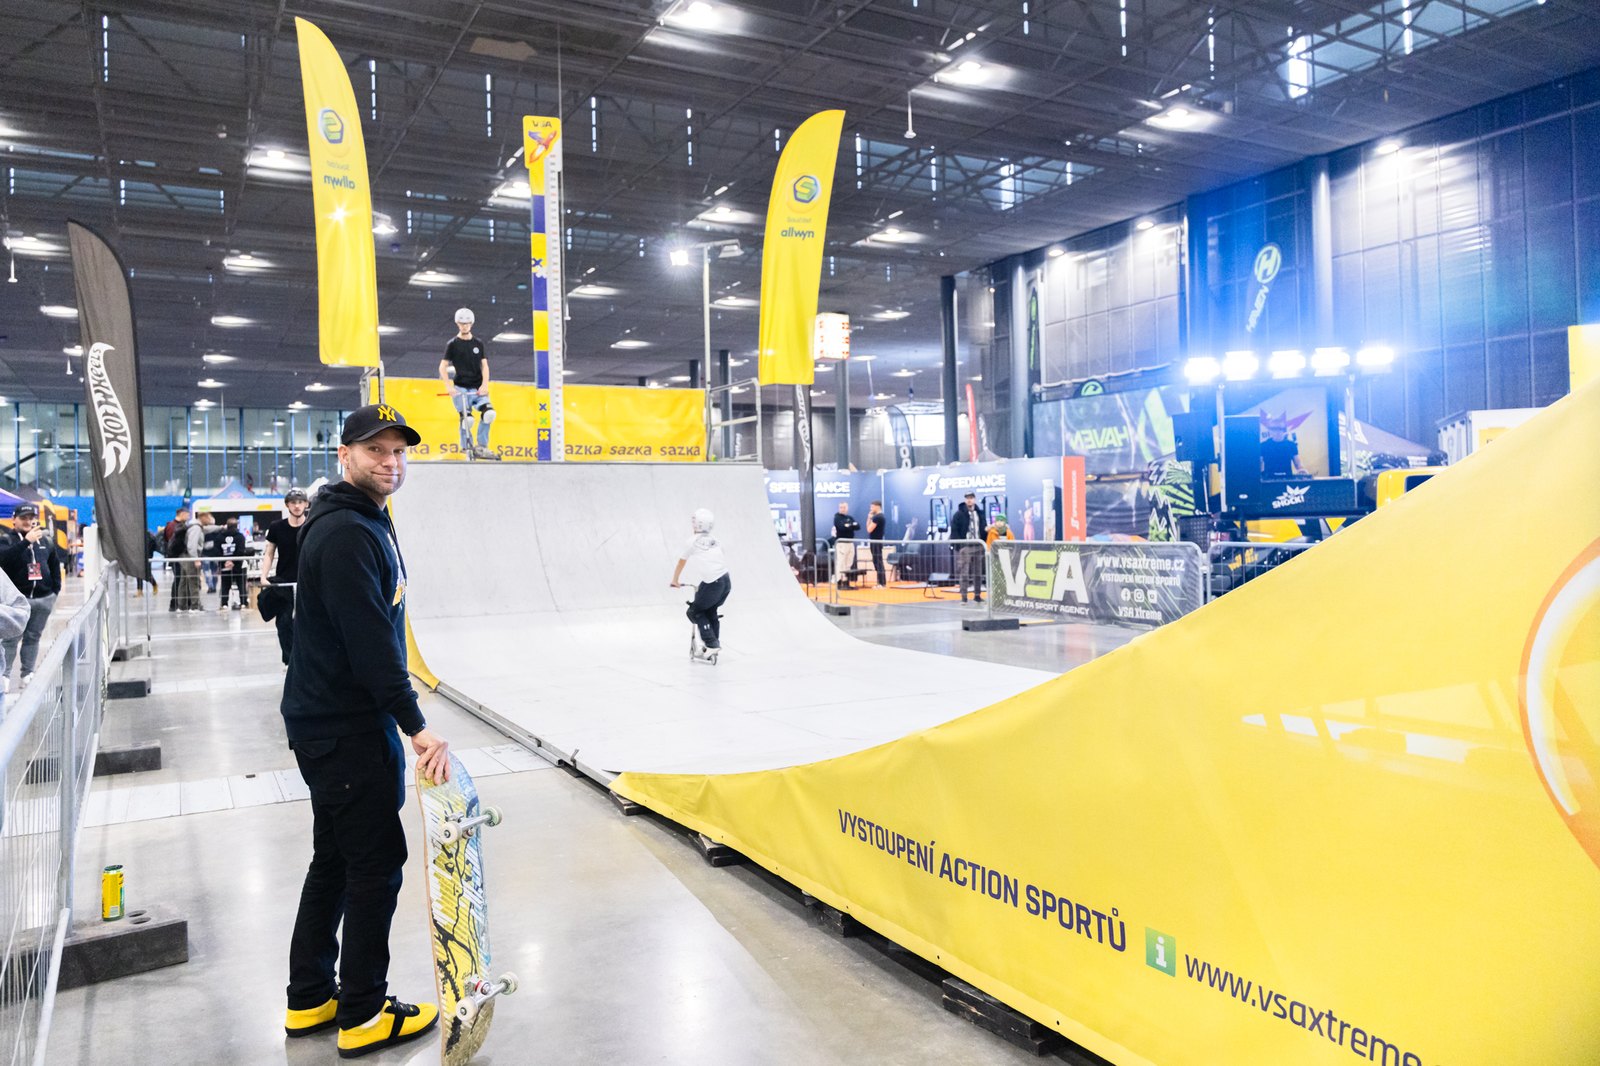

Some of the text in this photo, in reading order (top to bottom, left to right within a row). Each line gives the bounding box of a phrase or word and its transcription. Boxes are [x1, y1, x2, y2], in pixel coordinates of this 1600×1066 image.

[780, 227, 815, 240] allwyn
[102, 409, 128, 451] HOT
[564, 443, 602, 456] azka
[660, 445, 700, 457] sazka
[939, 474, 1006, 490] SPEEDIANCE
[998, 549, 1090, 604] VSA
[1035, 602, 1058, 612] SPORT
[1060, 604, 1090, 616] AGENCY
[838, 808, 1126, 952] VYSTOUPENÍ ACTION SPORTŮ
